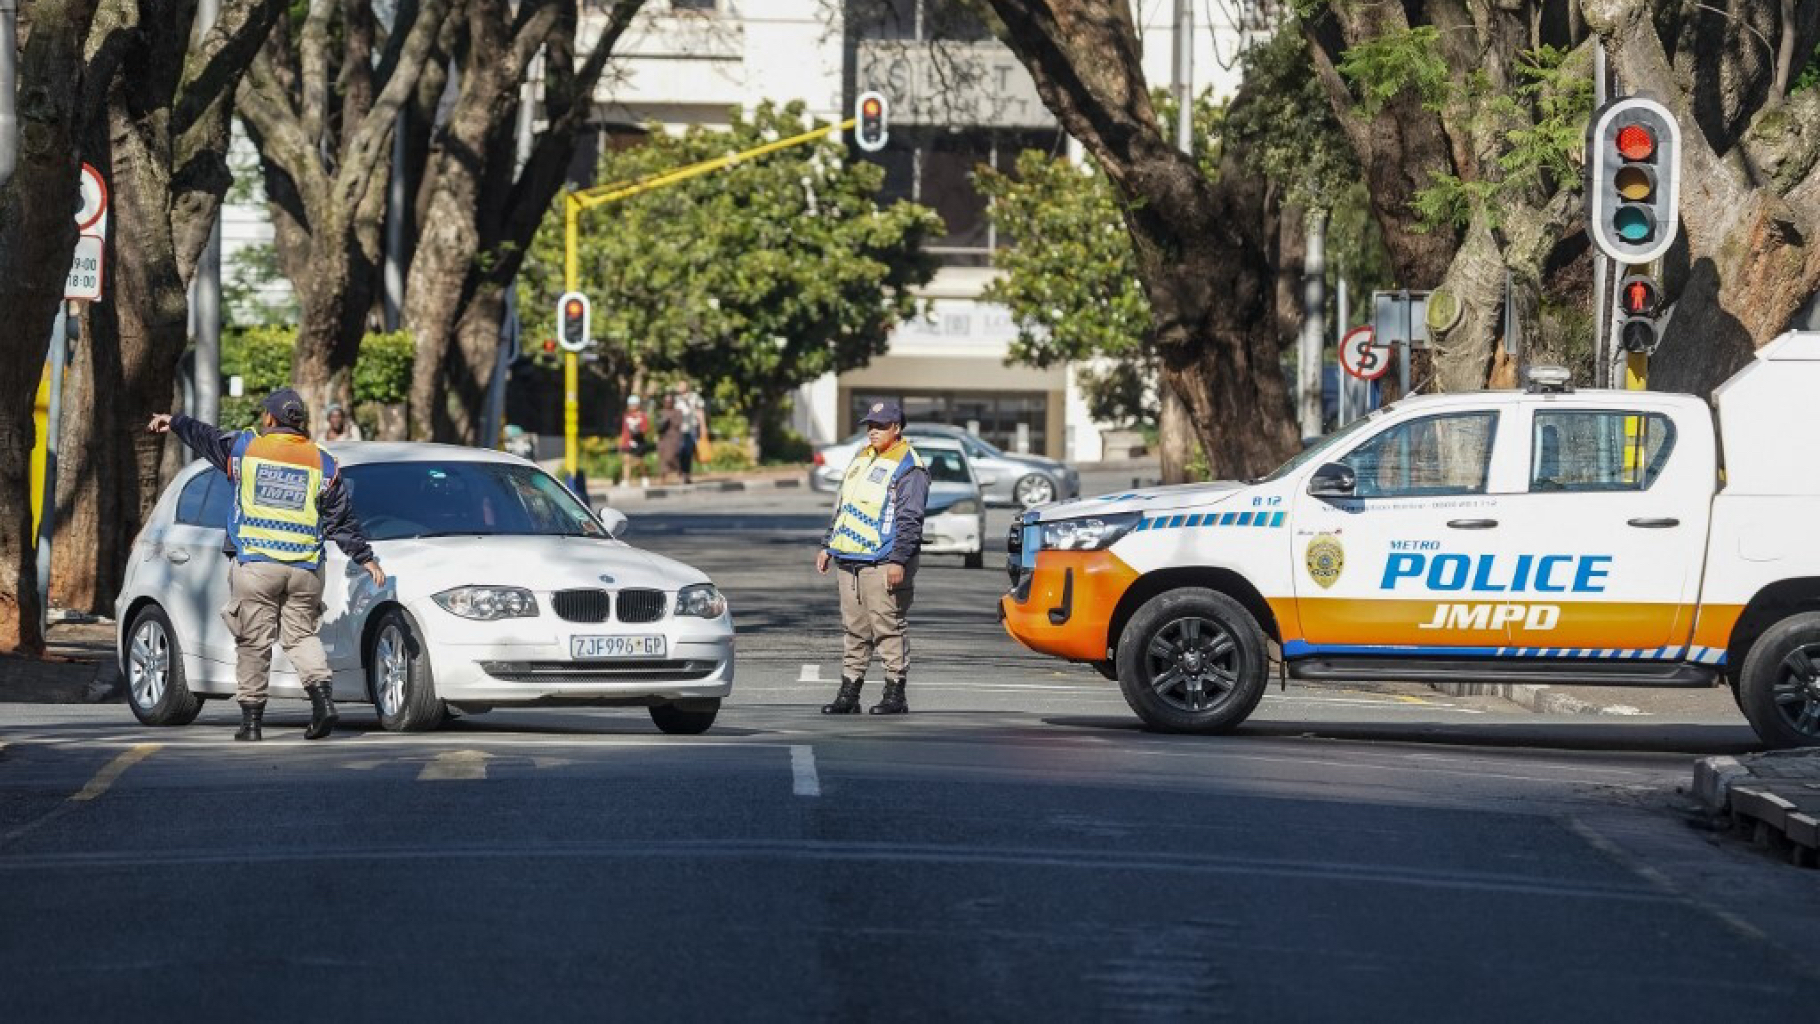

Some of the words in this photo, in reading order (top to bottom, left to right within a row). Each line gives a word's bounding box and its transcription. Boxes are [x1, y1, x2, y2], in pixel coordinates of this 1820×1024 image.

[68, 275, 96, 288] 18:00
[258, 469, 306, 485] POLICE
[1390, 540, 1441, 550] METRO
[1379, 552, 1613, 593] POLICE
[1418, 603, 1561, 630] JMPD
[644, 637, 662, 654] GP
